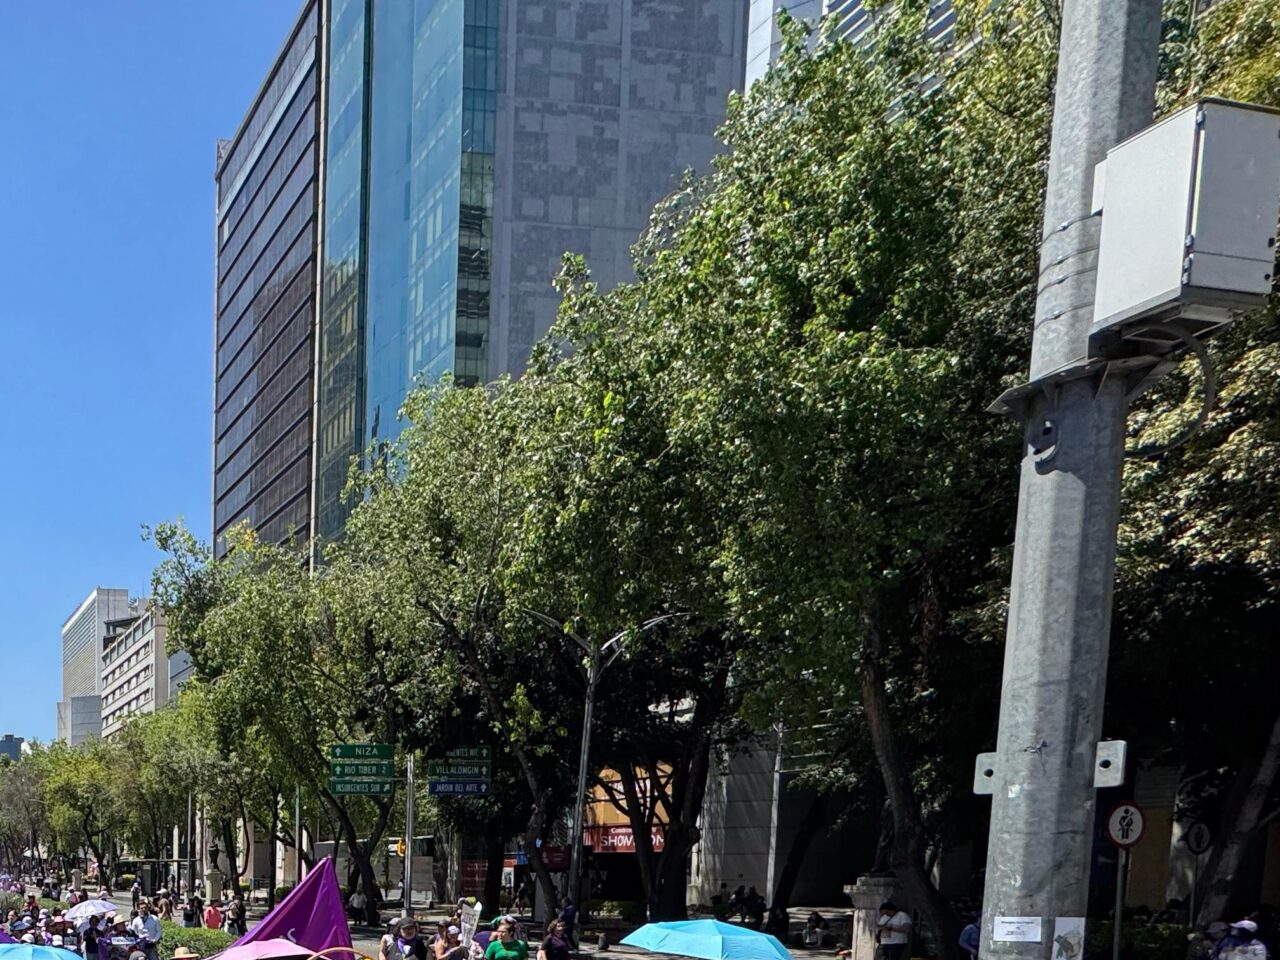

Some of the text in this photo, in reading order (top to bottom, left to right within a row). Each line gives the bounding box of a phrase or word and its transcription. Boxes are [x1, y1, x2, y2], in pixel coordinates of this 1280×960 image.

[355, 747, 379, 755] NIZA
[344, 765, 356, 775] RIO
[358, 765, 377, 775] TIBER
[436, 765, 479, 775] VILLALONGIN
[336, 783, 380, 792] INSURGENTES SUR
[435, 783, 478, 792] JARDIN DEL ARTE
